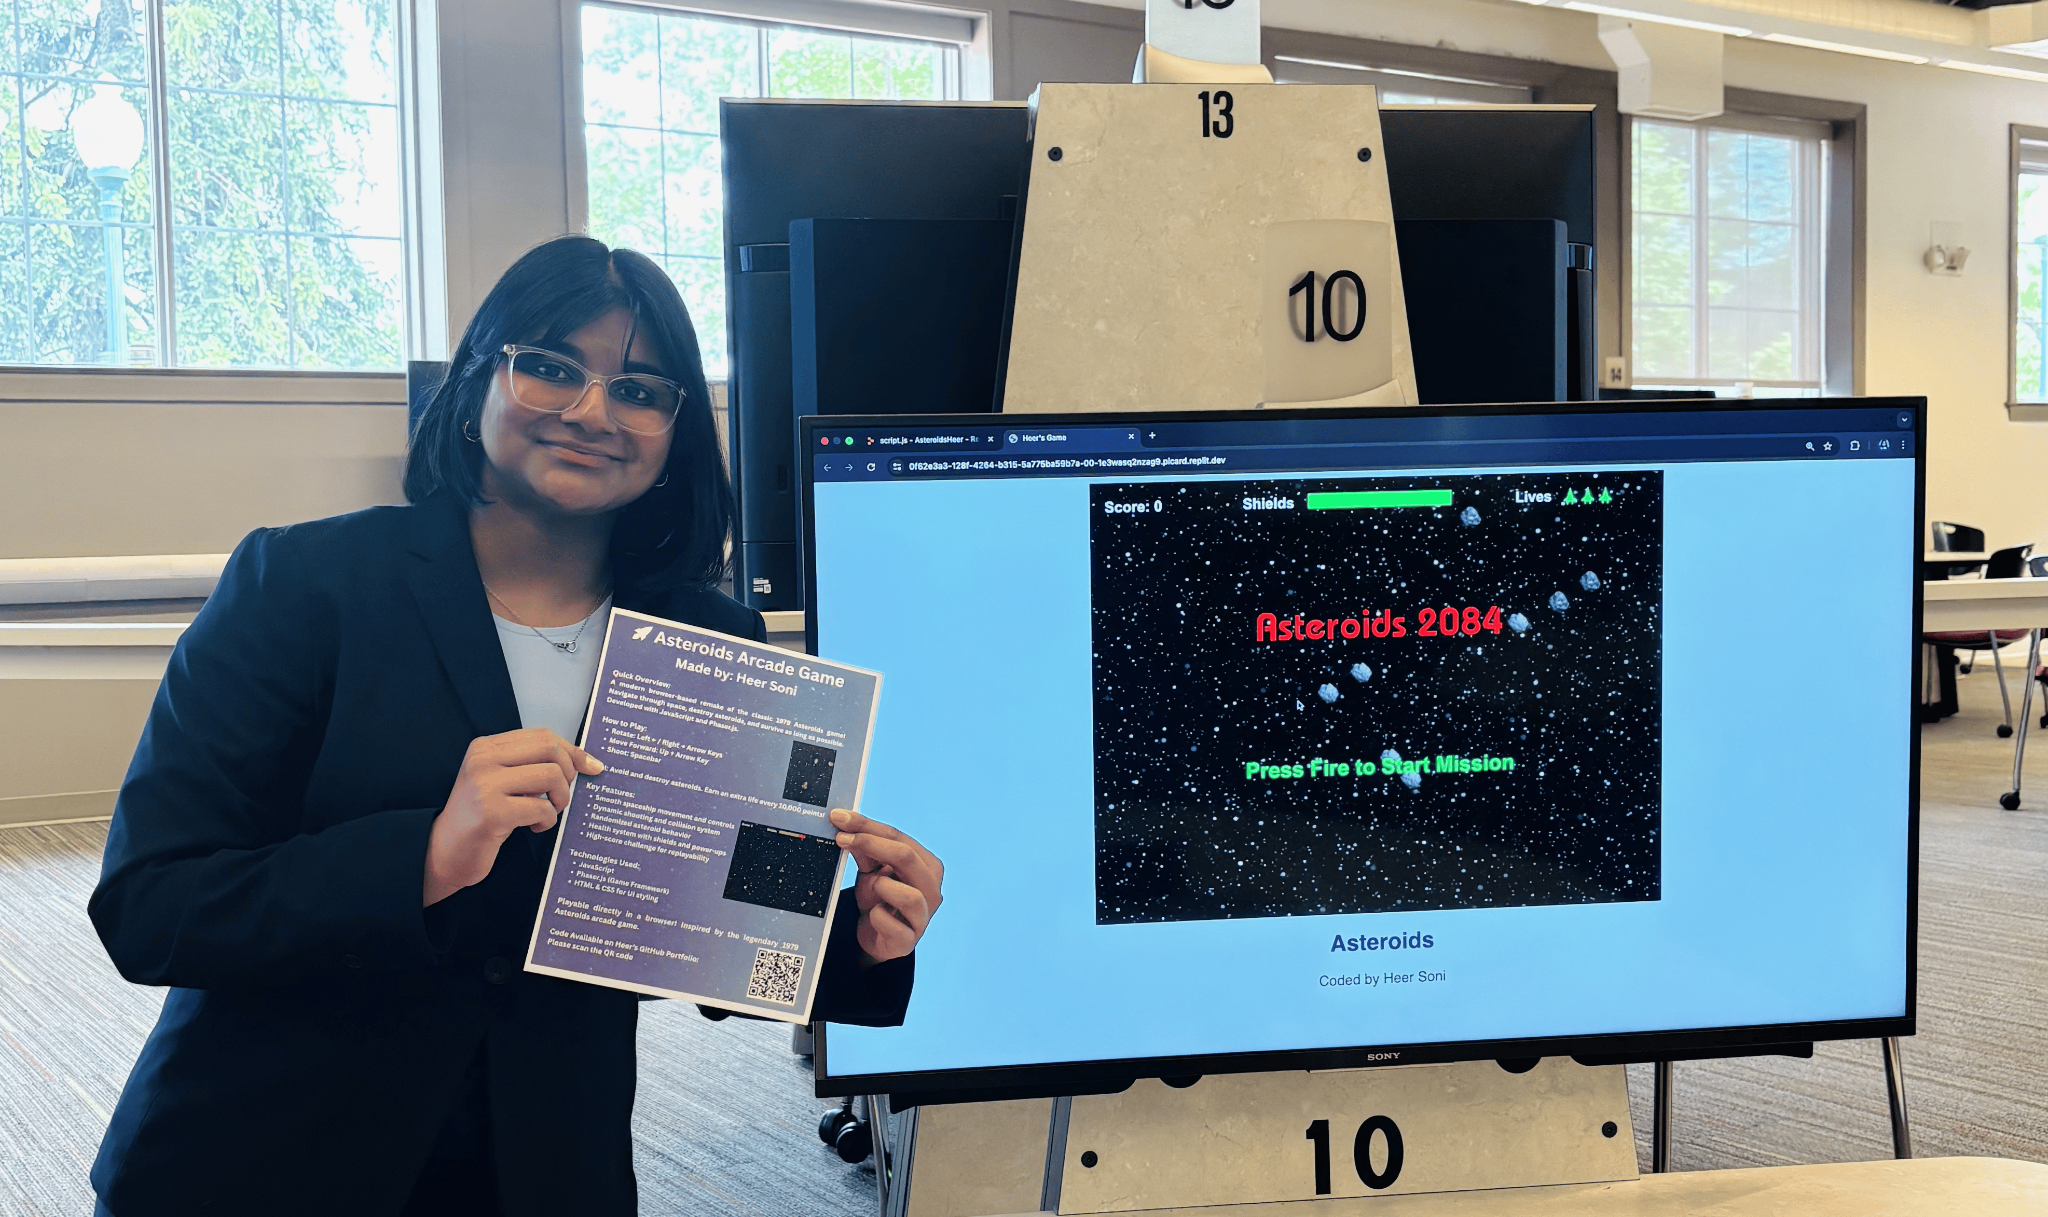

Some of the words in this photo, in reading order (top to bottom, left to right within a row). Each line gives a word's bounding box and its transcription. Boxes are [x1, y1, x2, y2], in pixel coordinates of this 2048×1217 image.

[1198, 91, 1233, 138] 13
[1289, 270, 1366, 342] 10
[1611, 368, 1621, 381] 14
[880, 436, 908, 445] script.js
[1105, 501, 1149, 514] Score:
[1153, 500, 1162, 513] 0
[1243, 497, 1295, 511] Shields
[1515, 489, 1552, 503] Lives
[1257, 609, 1406, 641] Asteroids
[1418, 606, 1503, 637] 2084
[653, 631, 734, 661] Asteroids
[736, 651, 794, 676] Arcade
[798, 666, 844, 688] Game
[612, 669, 634, 680] Quick
[675, 657, 711, 675] Made
[714, 666, 734, 682] by:
[736, 672, 767, 688] Heer
[769, 680, 798, 696] Soni
[606, 696, 643, 710] Developed
[619, 682, 645, 692] modern
[648, 687, 697, 704] browser-based
[700, 700, 724, 710] remake
[751, 712, 773, 721] classic
[776, 717, 791, 726] 1979
[793, 722, 823, 733] Asteroids
[602, 716, 619, 725] How
[629, 722, 647, 732] Play:
[608, 687, 638, 699] Navigate
[639, 695, 665, 706] through
[688, 706, 714, 718] destroy
[760, 724, 784, 733] survive
[793, 730, 807, 740] long
[816, 737, 843, 747] possible.
[609, 737, 628, 746] Move
[629, 741, 658, 753] Forward:
[659, 748, 669, 756] Up
[675, 752, 696, 761] Arrow
[696, 756, 710, 765] Key
[611, 728, 636, 738] Rotate:
[636, 733, 650, 742] Left
[662, 739, 680, 748] Right
[686, 745, 706, 754] Arrow
[707, 749, 723, 758] Keys
[630, 751, 662, 763] Spacebar
[1246, 762, 1304, 780] Press
[1308, 759, 1349, 777] Fire
[1355, 759, 1376, 776] to
[1382, 758, 1430, 776] Start
[1436, 754, 1515, 773] Mission
[586, 782, 600, 792] Key
[601, 785, 635, 798] Features:
[609, 766, 630, 776] Avoid
[644, 774, 670, 786] destroy
[670, 780, 703, 791] asteroids.
[704, 786, 719, 795] Earn
[729, 793, 746, 801] extra
[759, 800, 778, 809] every
[778, 802, 802, 813] 10,000
[802, 809, 825, 818] points!
[593, 803, 623, 815] Dynamic
[624, 810, 653, 822] shooting
[668, 820, 696, 830] collision
[696, 826, 720, 836] system
[595, 794, 622, 805] Smooth
[622, 801, 656, 813] spaceship
[657, 808, 693, 820] movement
[707, 819, 735, 829] controls
[590, 812, 632, 826] Randomized
[633, 823, 661, 832] asteroid
[662, 828, 691, 839] behavior
[586, 831, 623, 844] High-score
[623, 840, 656, 852] challenge
[668, 850, 709, 863] replayability
[588, 822, 611, 832] Health
[612, 828, 636, 837] system
[637, 833, 652, 841] with
[653, 836, 676, 846] shields
[691, 844, 726, 856] power-ups
[570, 848, 618, 864] Technologies
[574, 880, 594, 889] HTML
[601, 885, 615, 893] CSS
[616, 887, 626, 895] for
[636, 893, 658, 903] styling
[607, 876, 629, 886] (Game
[630, 881, 669, 895] Framework)
[554, 907, 590, 920] Asteroids
[591, 916, 617, 925] arcade
[616, 921, 639, 930] game.
[557, 897, 589, 909] Playable
[593, 904, 622, 917] directly
[625, 910, 633, 918] in
[680, 922, 711, 933] Inspired
[714, 928, 724, 937] by
[727, 931, 740, 939] the
[743, 934, 778, 948] legendary
[782, 942, 799, 950] 1979
[547, 938, 571, 948] Please
[572, 944, 589, 952] scan
[590, 946, 602, 955] the
[603, 948, 615, 957] QR
[615, 952, 633, 960] code
[549, 928, 569, 937] Code
[569, 932, 603, 944] Available
[639, 946, 665, 956] GitHub
[1331, 931, 1434, 952] Asteroids
[1319, 973, 1360, 987] Coded
[1364, 973, 1380, 987] by
[1384, 973, 1414, 984] Heer
[1418, 970, 1446, 982] Soni
[1367, 1052, 1401, 1061] SONY
[1306, 1115, 1404, 1195] 10
